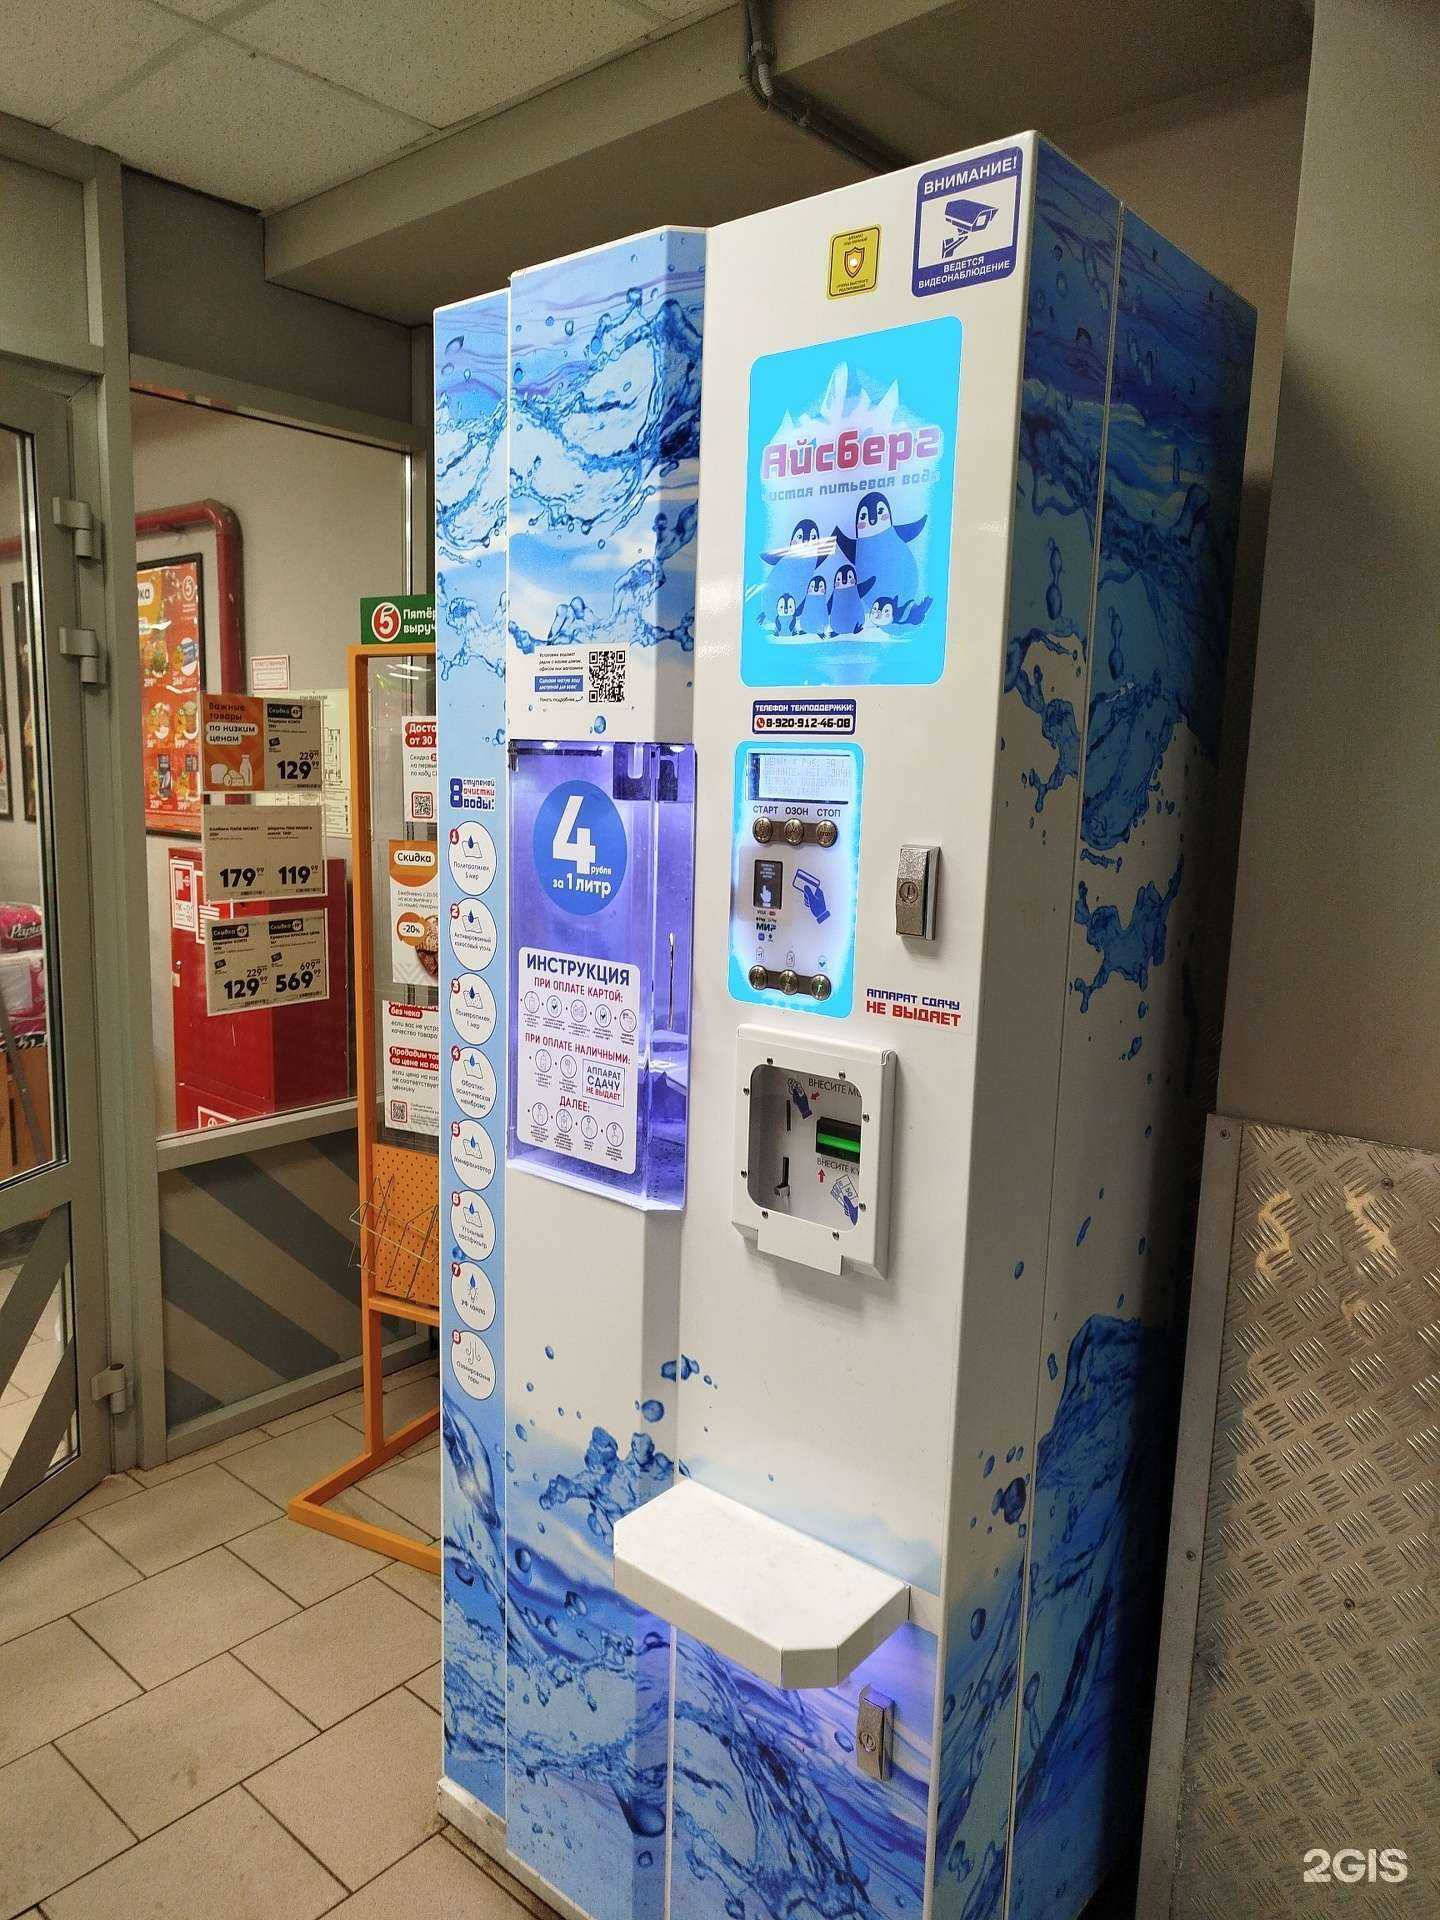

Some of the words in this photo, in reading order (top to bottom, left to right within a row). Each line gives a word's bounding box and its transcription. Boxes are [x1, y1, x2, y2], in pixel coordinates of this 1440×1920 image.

[924, 156, 1018, 195] ВНИМАНИЕ!
[943, 255, 985, 273] ВЕДЕТСЯ
[918, 260, 1010, 289] ВИДЕОНАБЛЮДЕНИЕ
[763, 427, 941, 479] Айсберг
[819, 477, 895, 496] питьевая
[208, 702, 246, 712] Важные
[755, 704, 788, 712] ТЕЛЕФОН
[791, 704, 854, 712] ТЕХПОДДЕРЖКИ:
[208, 713, 242, 722] товары
[766, 717, 851, 728] 8-920-912-46-08
[223, 725, 256, 733] низким
[209, 735, 240, 743] ценам
[409, 737, 420, 745] от
[422, 736, 433, 745] 30
[277, 760, 312, 779] 129
[463, 779, 495, 787] ступеней
[450, 778, 463, 808] 8
[463, 787, 495, 796] очистки
[463, 797, 495, 811] воды:
[752, 805, 778, 815] СТАРТ
[785, 807, 809, 816] ОЗОН
[817, 808, 841, 818] СТОП
[552, 795, 596, 875] 4
[397, 852, 432, 863] Скидка
[220, 868, 256, 888] 179
[278, 866, 311, 885] 119
[591, 866, 612, 876] рубля
[552, 879, 564, 889] за
[567, 873, 573, 890] 1
[576, 878, 612, 899] литр
[402, 924, 421, 934] -20%
[756, 923, 777, 932] МИР
[246, 968, 262, 978] 229
[300, 961, 316, 972] 699
[527, 953, 630, 986] ИНСТРУКЦИЯ
[224, 978, 260, 1000] 129
[275, 970, 314, 993] 569
[534, 976, 551, 989] ПРИ
[553, 980, 585, 996] ОПЛАТЕ
[587, 986, 623, 1003] КАРТОЙ:
[866, 988, 918, 1004] АППАРАТ
[922, 996, 960, 1011] СДАЧУ
[391, 1008, 403, 1016] без
[404, 1009, 421, 1018] чека
[866, 1000, 886, 1015] НЕ
[892, 1004, 961, 1027] ВЫДАЕТ
[391, 1029, 416, 1037] качество
[391, 1046, 427, 1059] Продадим
[525, 1032, 541, 1043] ПРИ
[543, 1036, 573, 1051] ОПЛАТЕ
[575, 1044, 631, 1065] НАЛИЧНЫМИ:
[391, 1057, 401, 1065] по
[401, 1059, 419, 1068] цене
[420, 1060, 429, 1068] на
[587, 1065, 621, 1081] АППАРАТ
[587, 1075, 621, 1092] СДАЧУ
[808, 1078, 847, 1094] ВНЕСИТЕ
[586, 1086, 594, 1096] НЕ
[595, 1088, 621, 1101] ВЫДАЕТ
[559, 1095, 590, 1113] ДАЛЕЕ:
[816, 1157, 849, 1172] ВНЕСИТЕ
